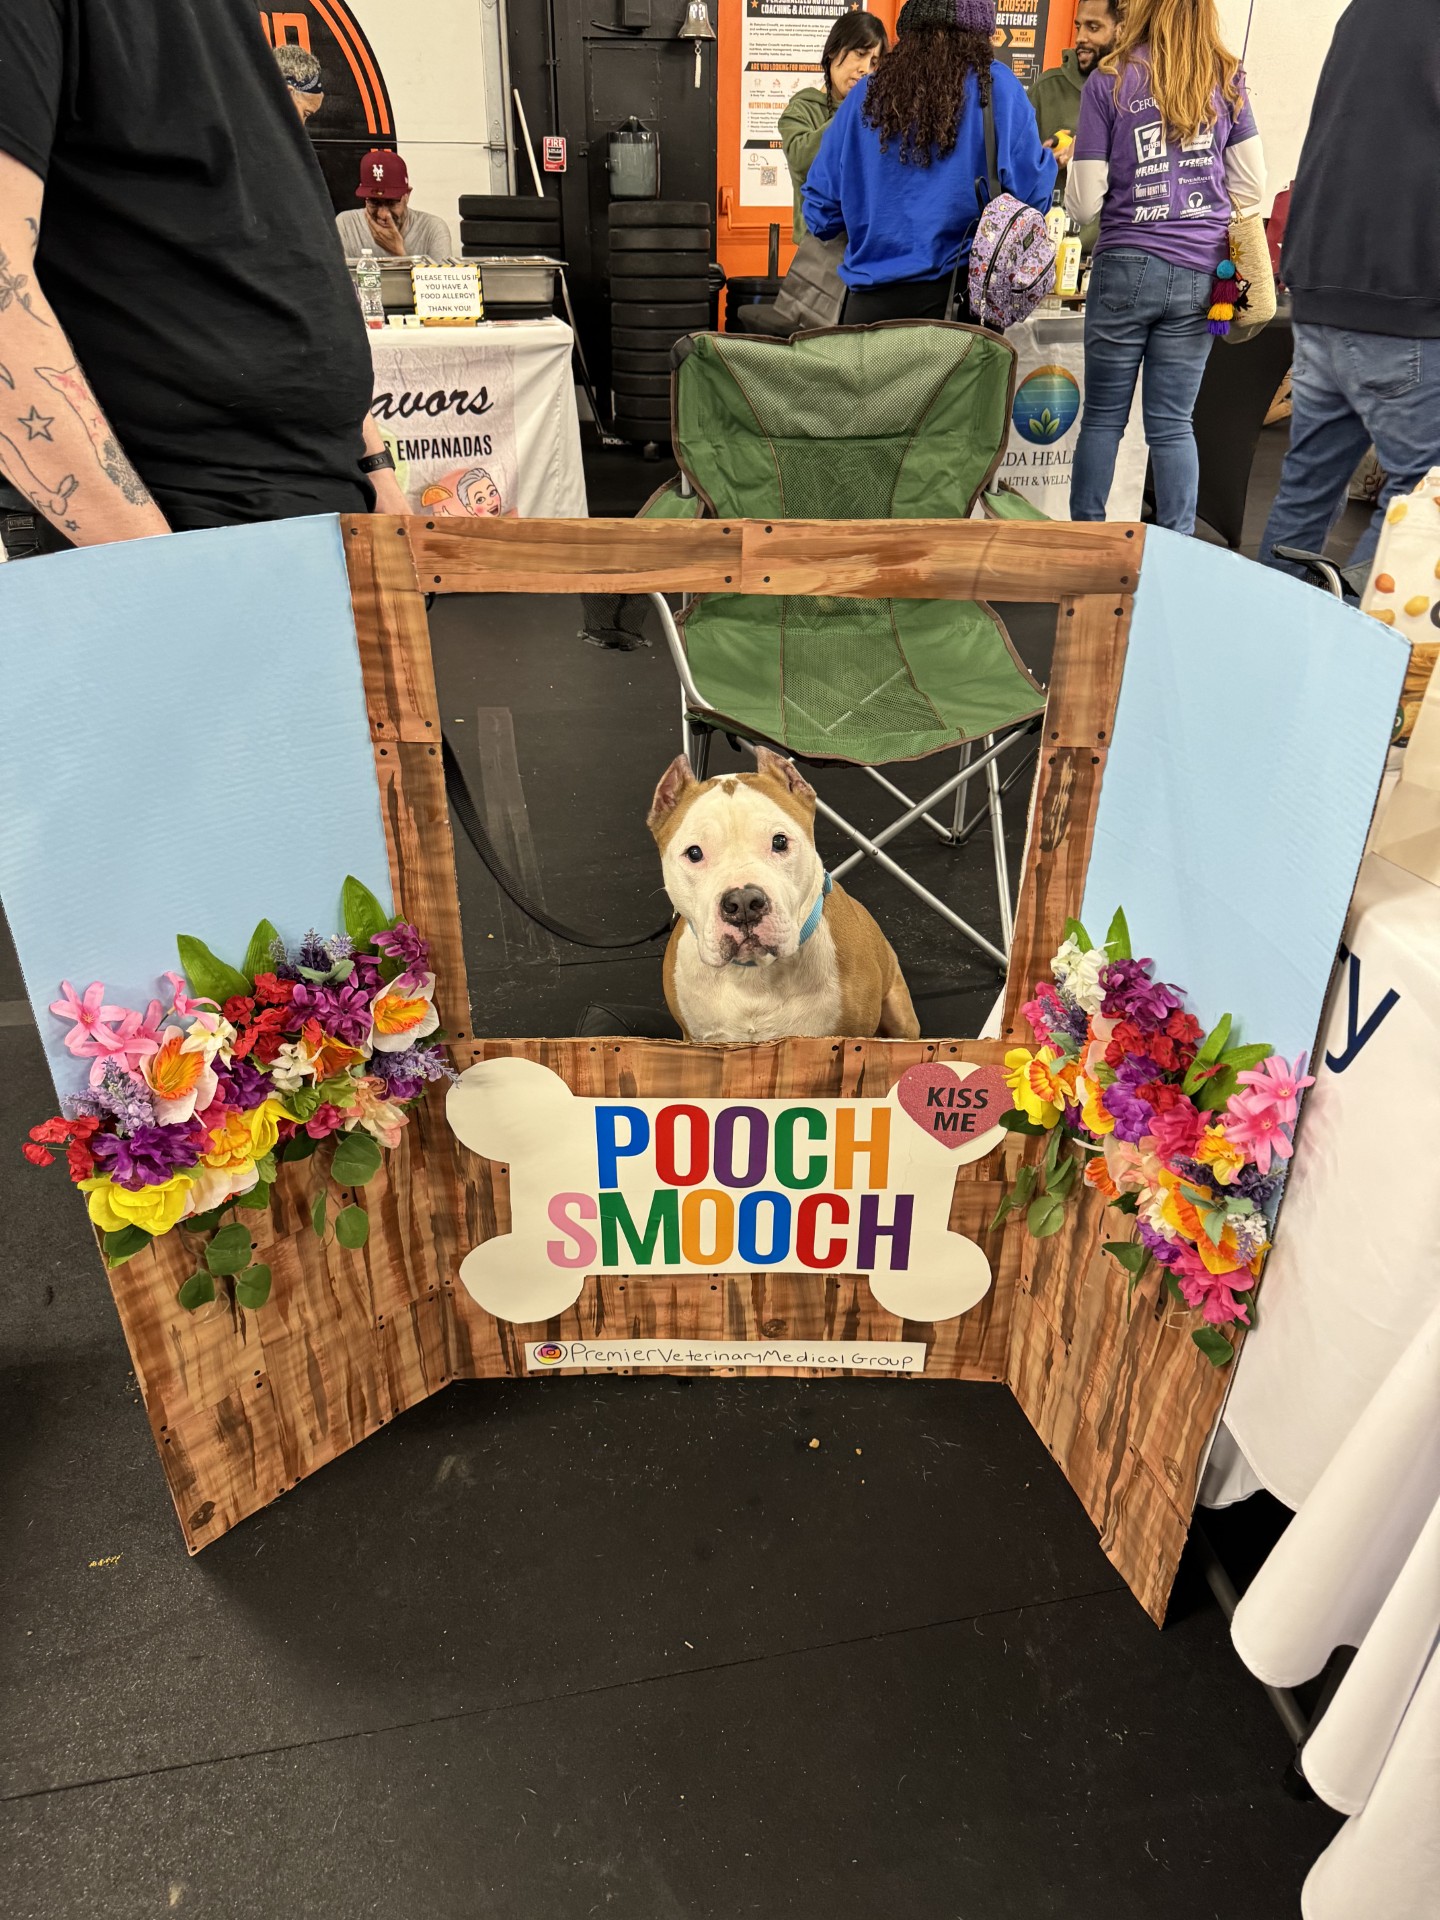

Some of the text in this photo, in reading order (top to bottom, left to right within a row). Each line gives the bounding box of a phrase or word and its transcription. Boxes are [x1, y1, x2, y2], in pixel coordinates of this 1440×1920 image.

[761, 5, 849, 16] COACHING & ACCOUNTABILITY
[996, 13, 1038, 26] BETTER LIFE
[546, 138, 563, 147] FIRE
[1178, 155, 1214, 168] TREK
[1135, 162, 1169, 178] MERLIN
[397, 434, 493, 461] EMPANADAS
[1031, 476, 1040, 486] &
[927, 1087, 989, 1110] KISS
[933, 1112, 977, 1133] ME
[595, 1104, 892, 1191] POOCH
[546, 1188, 915, 1271] SMOOCH
